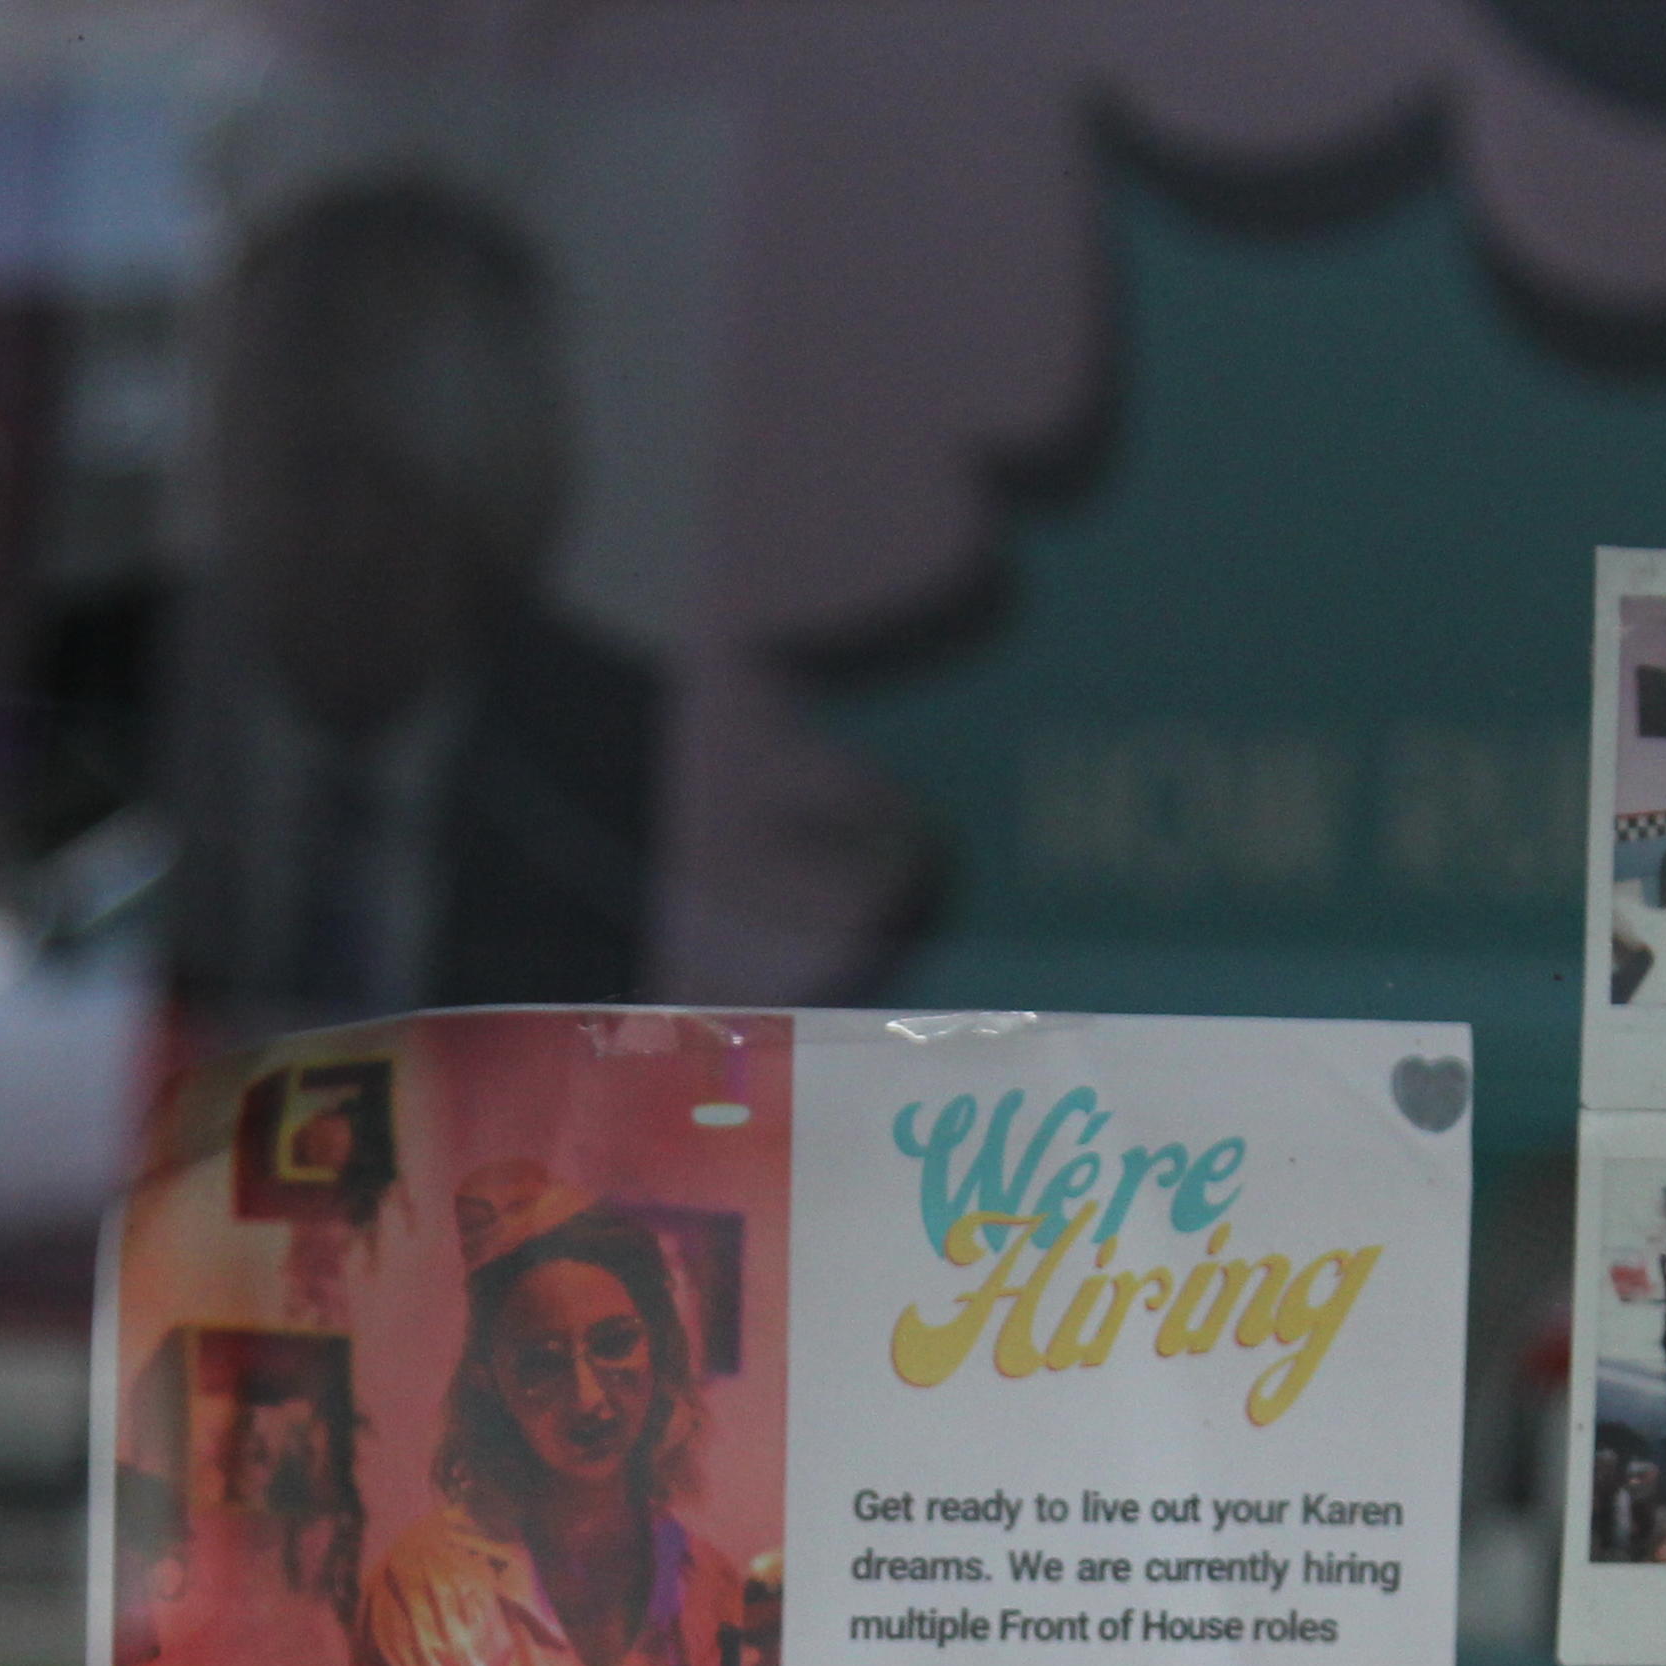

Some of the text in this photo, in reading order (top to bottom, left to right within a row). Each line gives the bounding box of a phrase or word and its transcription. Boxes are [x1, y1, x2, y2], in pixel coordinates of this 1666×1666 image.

[889, 1198, 1386, 1429] Hiring
[851, 1487, 1404, 1531] Get ready to live out your Karen
[849, 1546, 1402, 1596] dreams. We are currently hiring
[848, 1607, 1339, 1652] multiple Front of House roles
